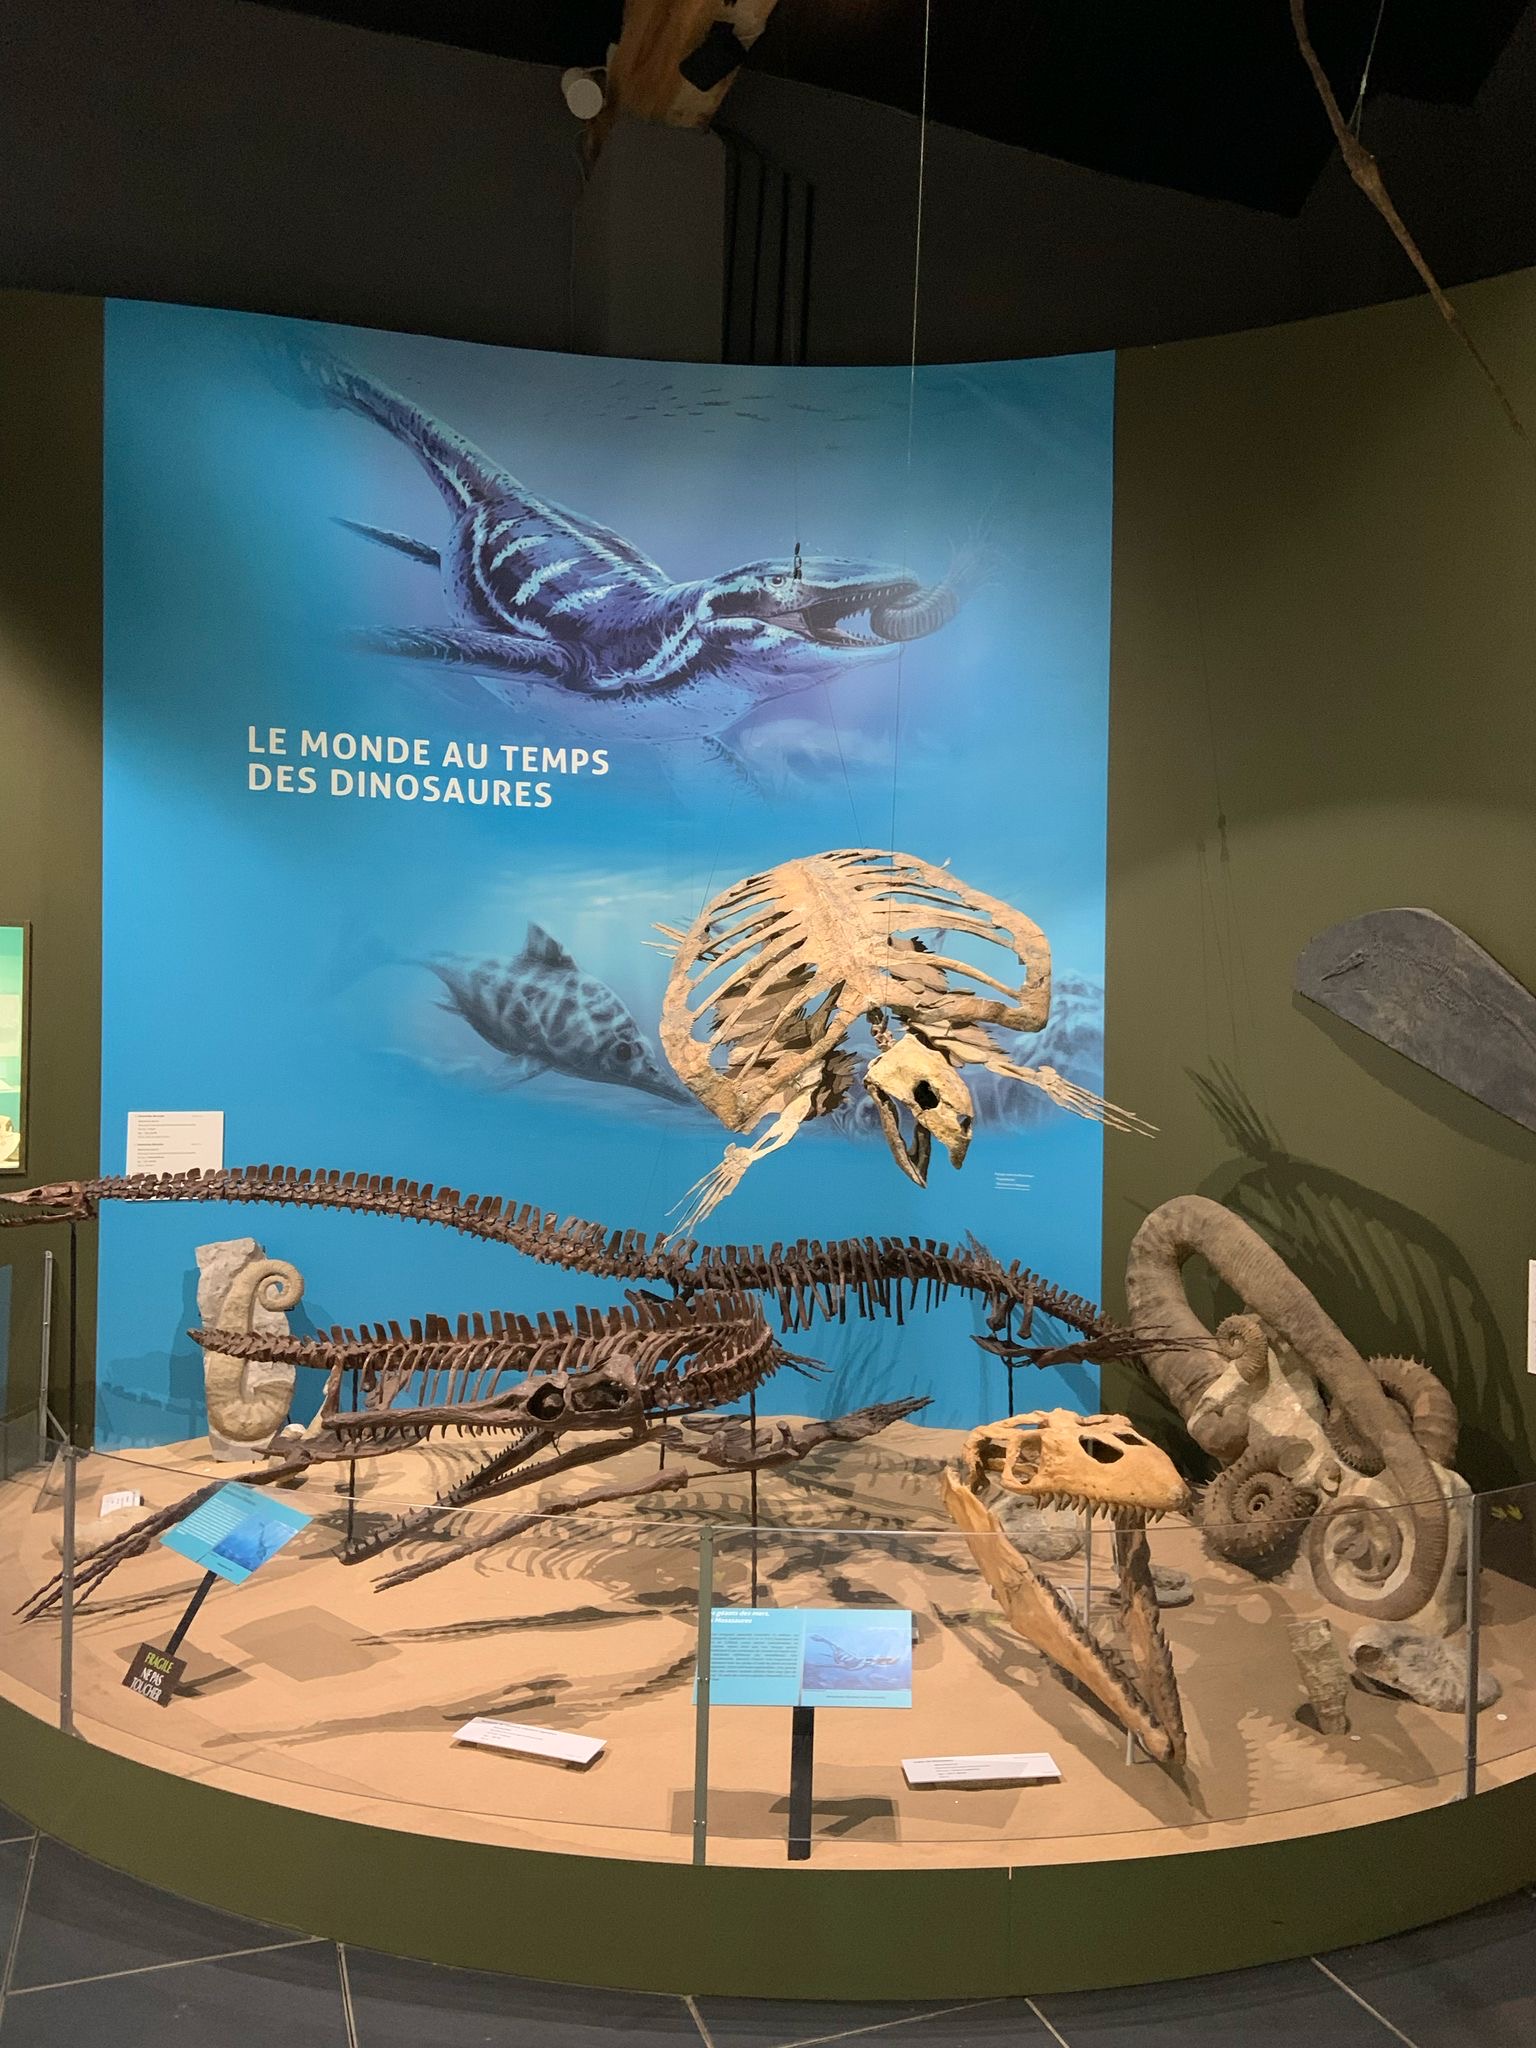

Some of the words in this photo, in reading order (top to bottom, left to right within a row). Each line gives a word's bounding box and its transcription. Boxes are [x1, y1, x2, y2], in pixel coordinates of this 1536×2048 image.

[248, 725, 287, 755] LE
[300, 730, 430, 766] MONDE
[442, 741, 488, 769] AU
[500, 745, 609, 775] TEMPS
[248, 763, 317, 794] DES
[330, 769, 552, 808] DINOSAURES
[144, 1652, 174, 1673] FRAGILE
[130, 1676, 162, 1701] TOUCHER
[141, 1667, 153, 1681] NE
[149, 1671, 164, 1686] PAS
